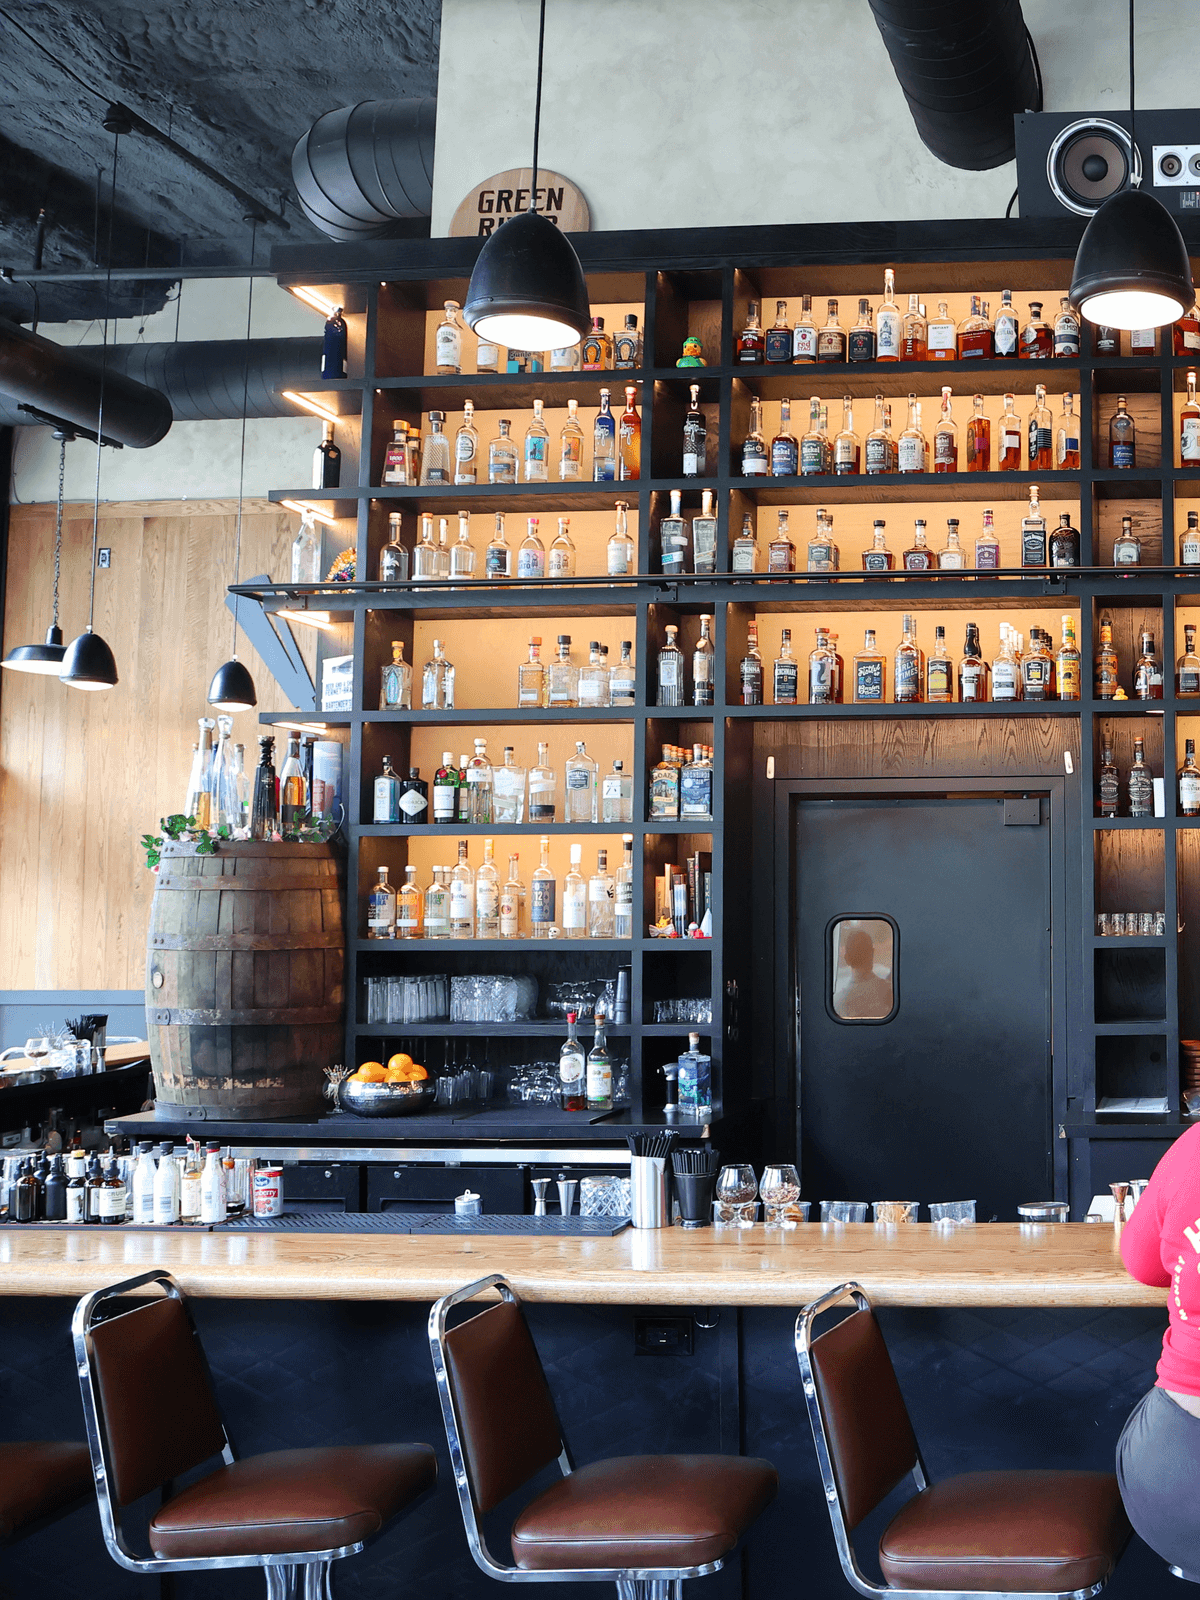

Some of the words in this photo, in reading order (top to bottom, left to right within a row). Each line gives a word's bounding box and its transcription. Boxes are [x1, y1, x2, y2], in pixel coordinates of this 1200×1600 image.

[477, 187, 564, 213] GREEN
[906, 324, 914, 352] TINCUP
[255, 1190, 278, 1198] nberry
